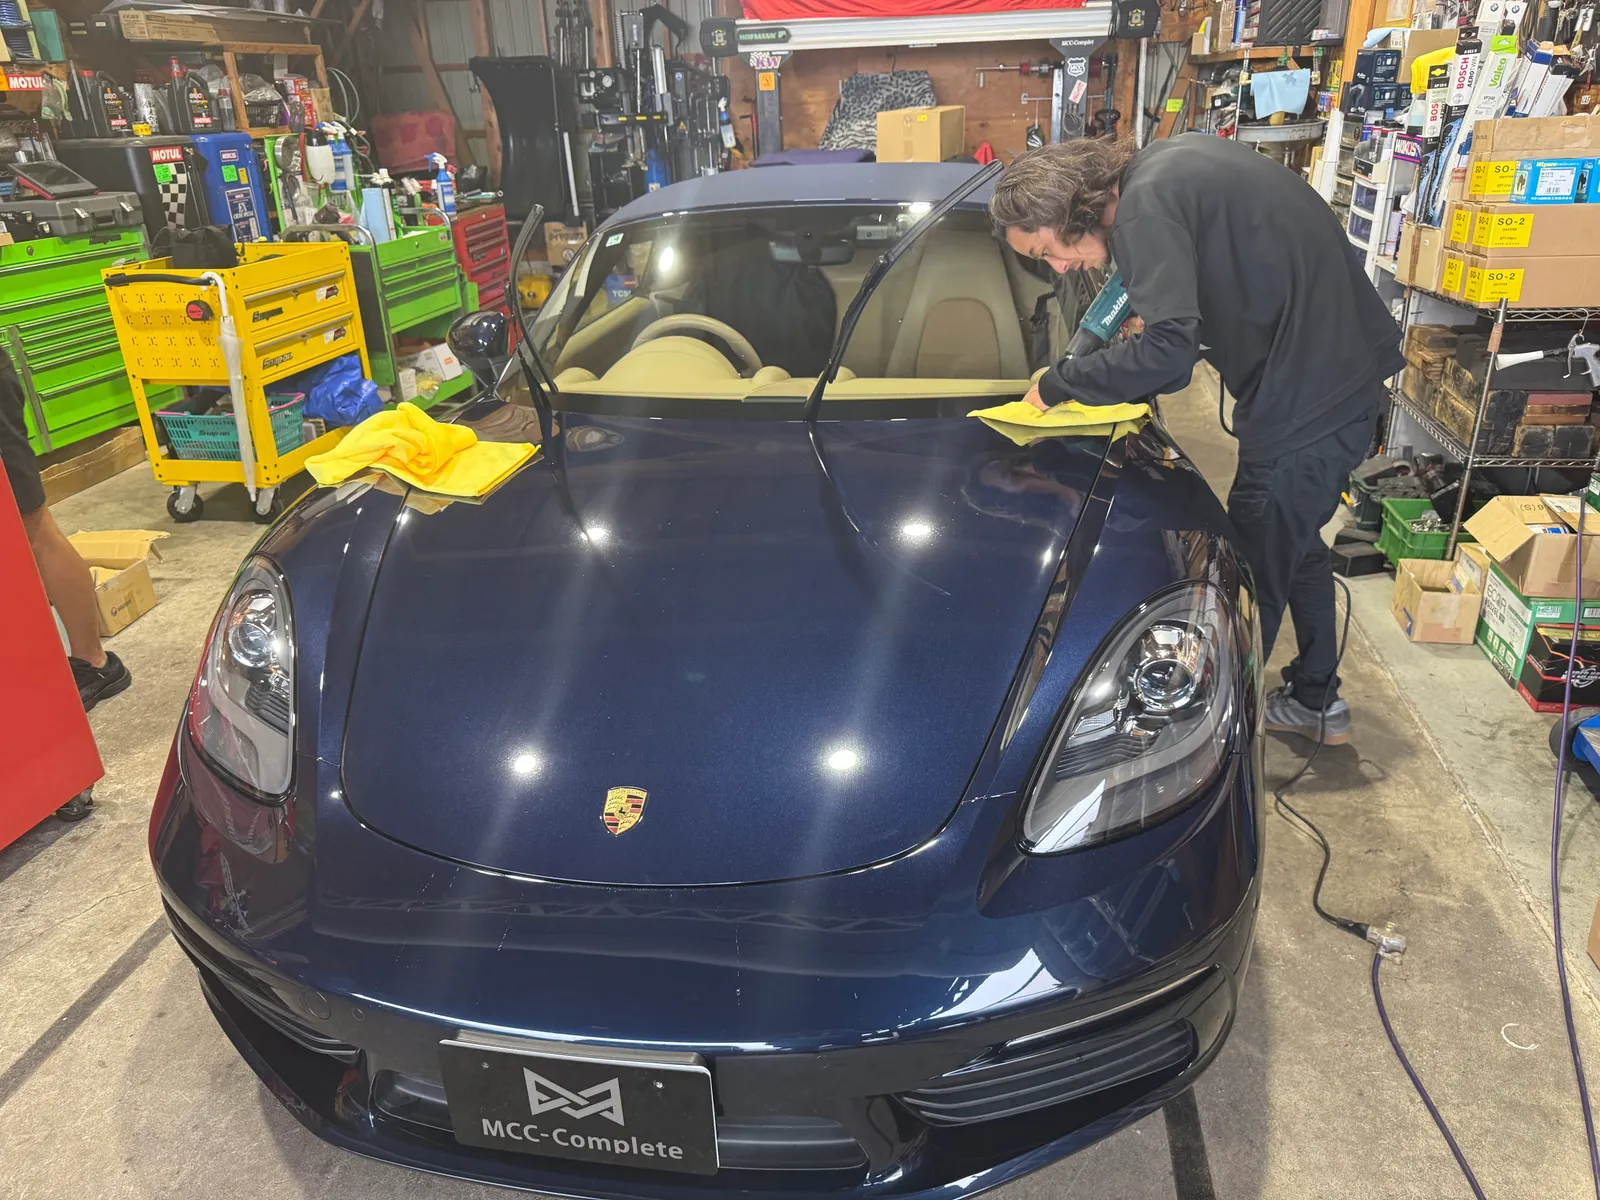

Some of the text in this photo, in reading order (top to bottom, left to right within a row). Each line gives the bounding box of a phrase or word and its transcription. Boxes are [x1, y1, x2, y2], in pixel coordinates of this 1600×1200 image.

[755, 55, 781, 70] KW
[1456, 57, 1470, 90] BOSCH
[1488, 58, 1507, 87] Valeo
[153, 148, 182, 161] MOTUL
[1494, 165, 1514, 173] SO-
[1497, 217, 1526, 226] SO-2
[1488, 272, 1516, 281] SO-2
[481, 1117, 684, 1160] MCC-Complete
